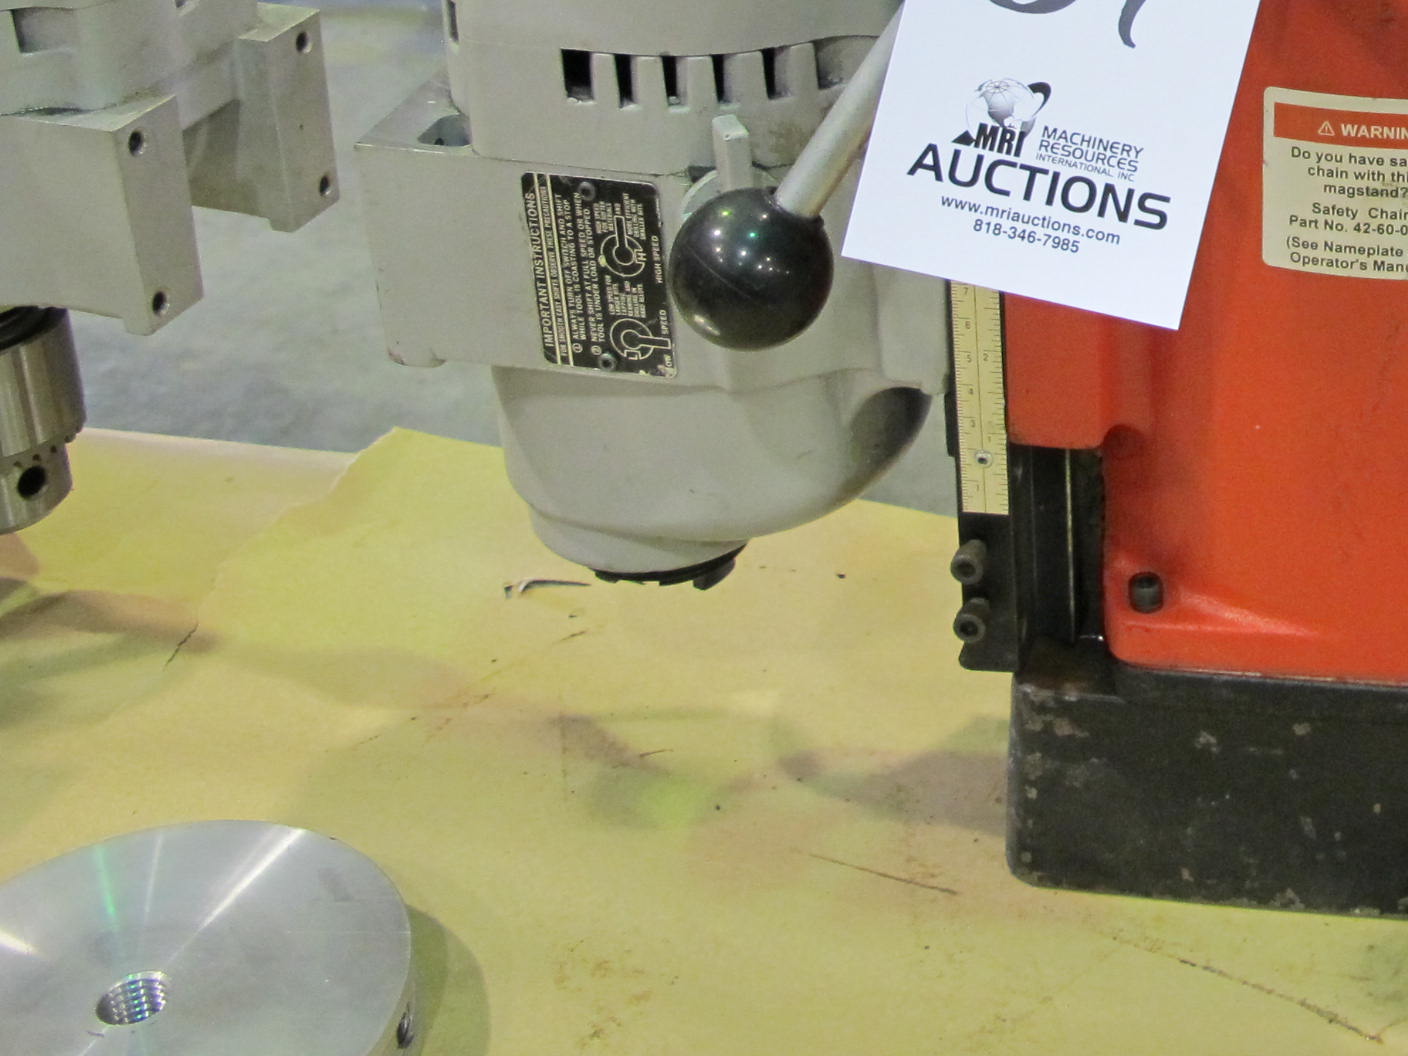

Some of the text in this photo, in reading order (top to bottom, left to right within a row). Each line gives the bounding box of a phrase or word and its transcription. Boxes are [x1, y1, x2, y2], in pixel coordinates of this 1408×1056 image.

[974, 122, 1025, 158] MRI
[1042, 126, 1144, 159] MACHINERY
[1036, 153, 1135, 182] INTERNATIONAL INC
[1038, 139, 1139, 172] RESOURCES
[1291, 146, 1310, 160] Do
[1316, 151, 1343, 163] you
[1349, 153, 1384, 166] have
[907, 143, 1172, 230] AUCTIONS
[1308, 166, 1348, 179] chain
[1354, 170, 1385, 183] with
[1324, 184, 1408, 198] magstand?
[555, 194, 563, 216] SHIFT
[574, 192, 582, 216] WHEN
[1312, 202, 1358, 220] Safety
[577, 219, 584, 229] OR
[584, 209, 593, 244] STOPPED
[941, 195, 1120, 246] www.mriauctions.com
[1289, 215, 1319, 229] Part
[1324, 220, 1348, 232] No.
[566, 230, 573, 240] TO
[578, 232, 587, 257] SPEED
[973, 218, 1080, 254] 818-346-7985
[1286, 236, 1318, 250] (See
[1324, 241, 1403, 259] Nameplate
[560, 238, 569, 266] SWITCH
[651, 235, 660, 261] SPEED
[525, 193, 554, 346] IMPORTANT INSTRUCTIONS
[570, 243, 579, 281] COASTING
[590, 260, 598, 281] LOAD
[654, 263, 663, 283] HIGH
[1290, 252, 1367, 270] Operator's
[584, 282, 591, 290] AT
[593, 284, 601, 310] UNDER
[570, 310, 578, 339] ALWAYS
[588, 316, 597, 342] NEVER
[597, 322, 605, 342] TOOL
[659, 309, 668, 334] SPEED
